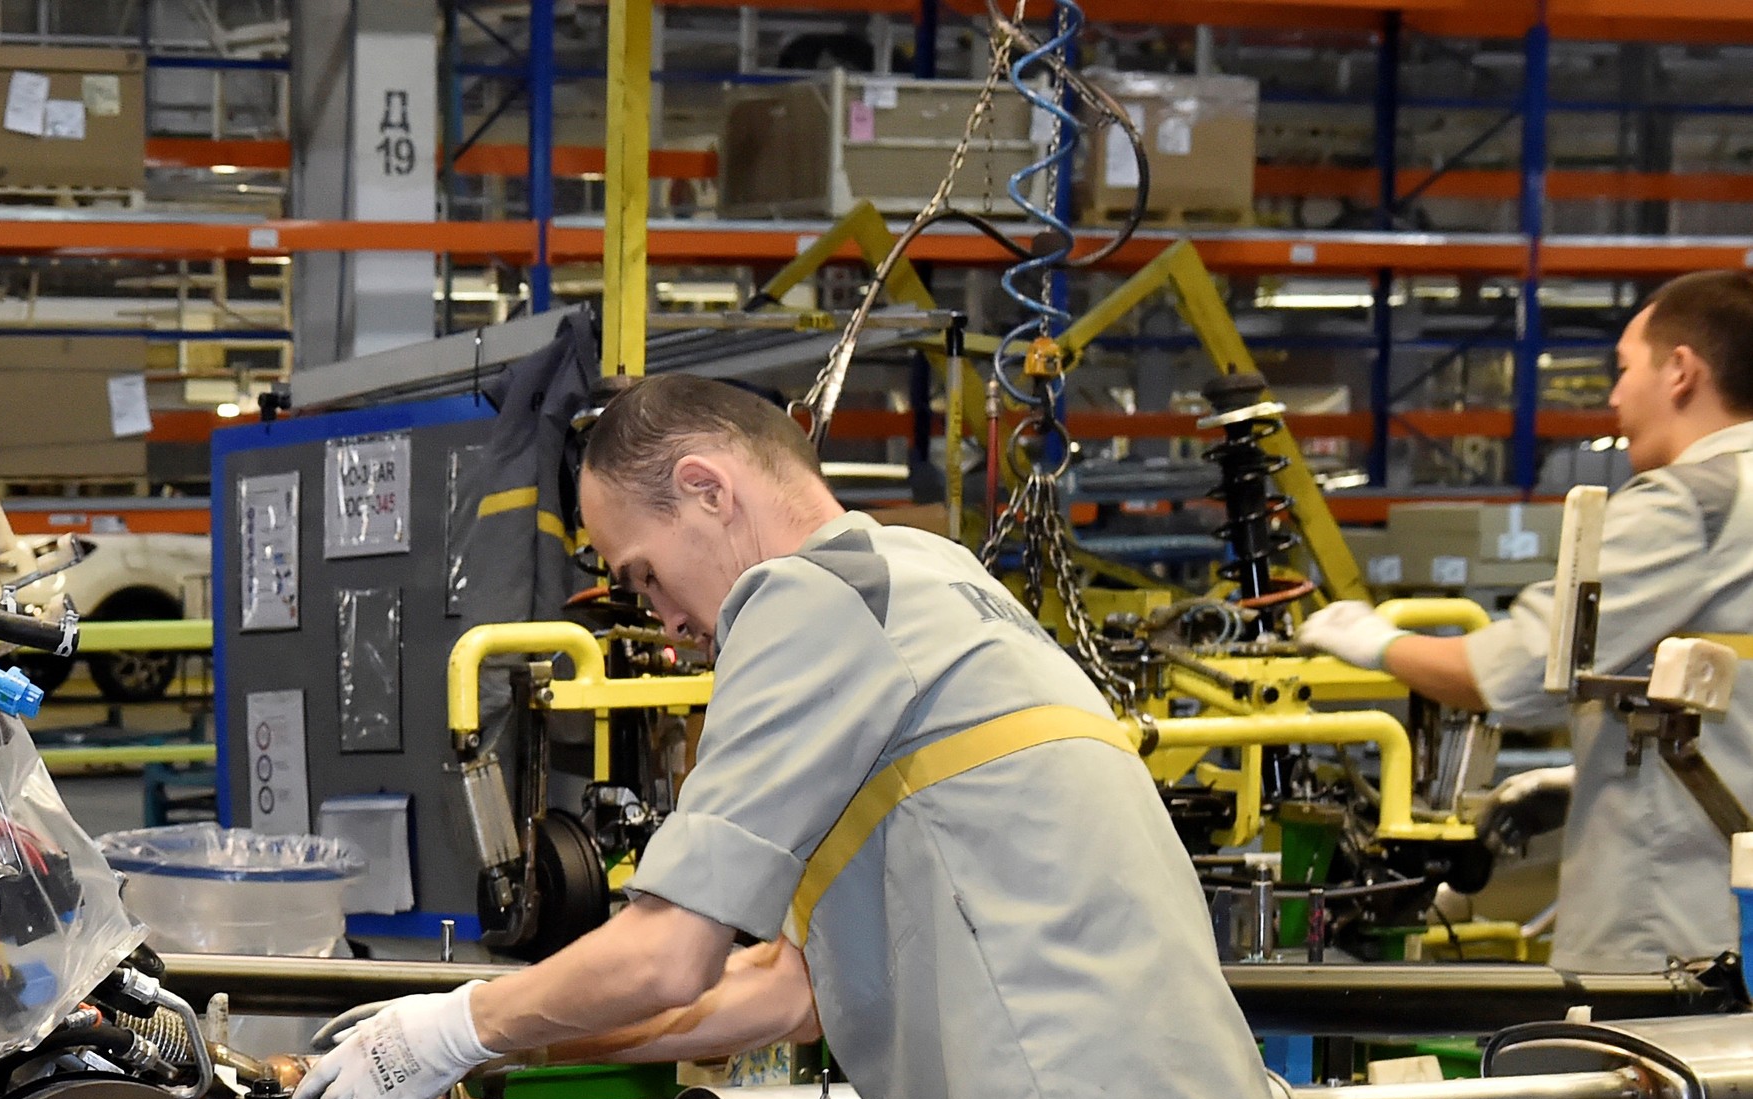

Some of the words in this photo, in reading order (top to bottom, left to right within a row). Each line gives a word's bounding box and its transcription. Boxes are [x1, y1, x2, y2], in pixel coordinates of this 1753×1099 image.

[379, 89, 409, 132] Д
[375, 137, 415, 174] 19
[393, 1069, 406, 1084] 07
